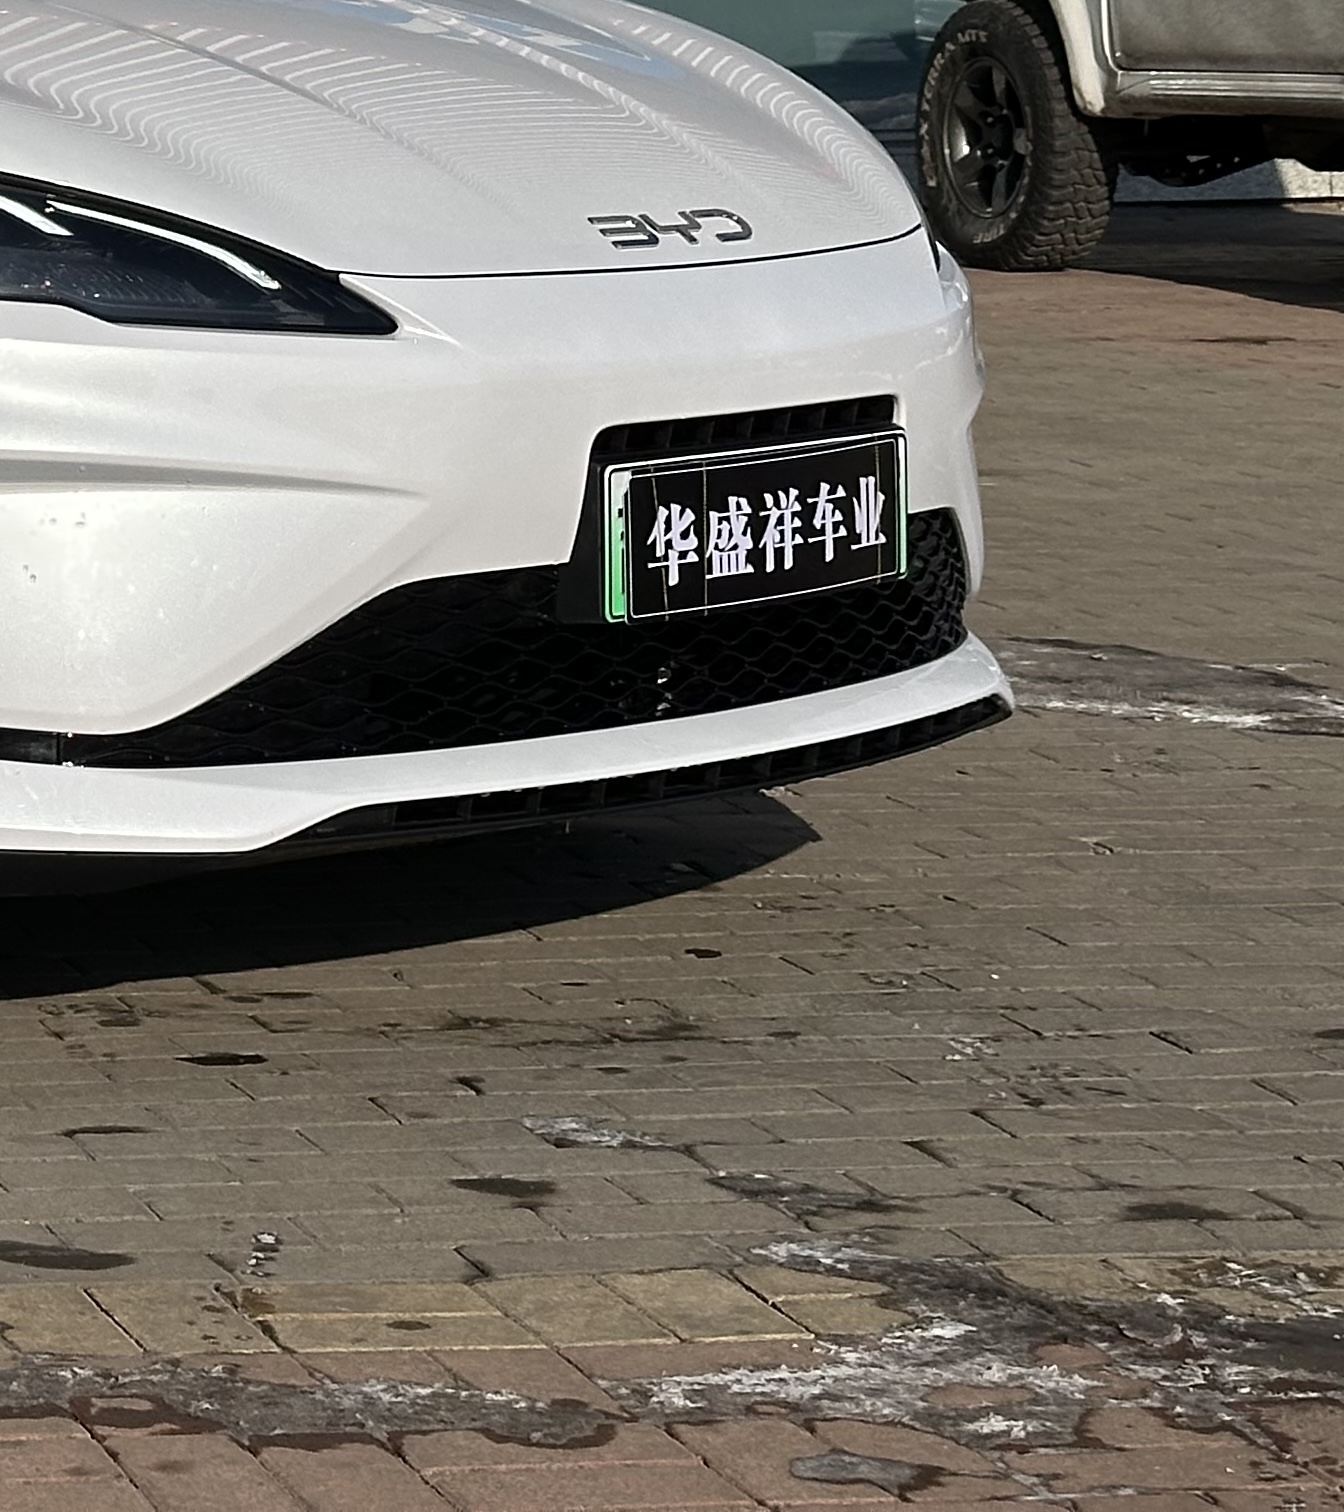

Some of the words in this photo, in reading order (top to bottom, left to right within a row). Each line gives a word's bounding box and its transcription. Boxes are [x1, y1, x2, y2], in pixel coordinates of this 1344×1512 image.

[587, 207, 754, 250] BYD
[646, 474, 887, 587] 华盛祥车业
